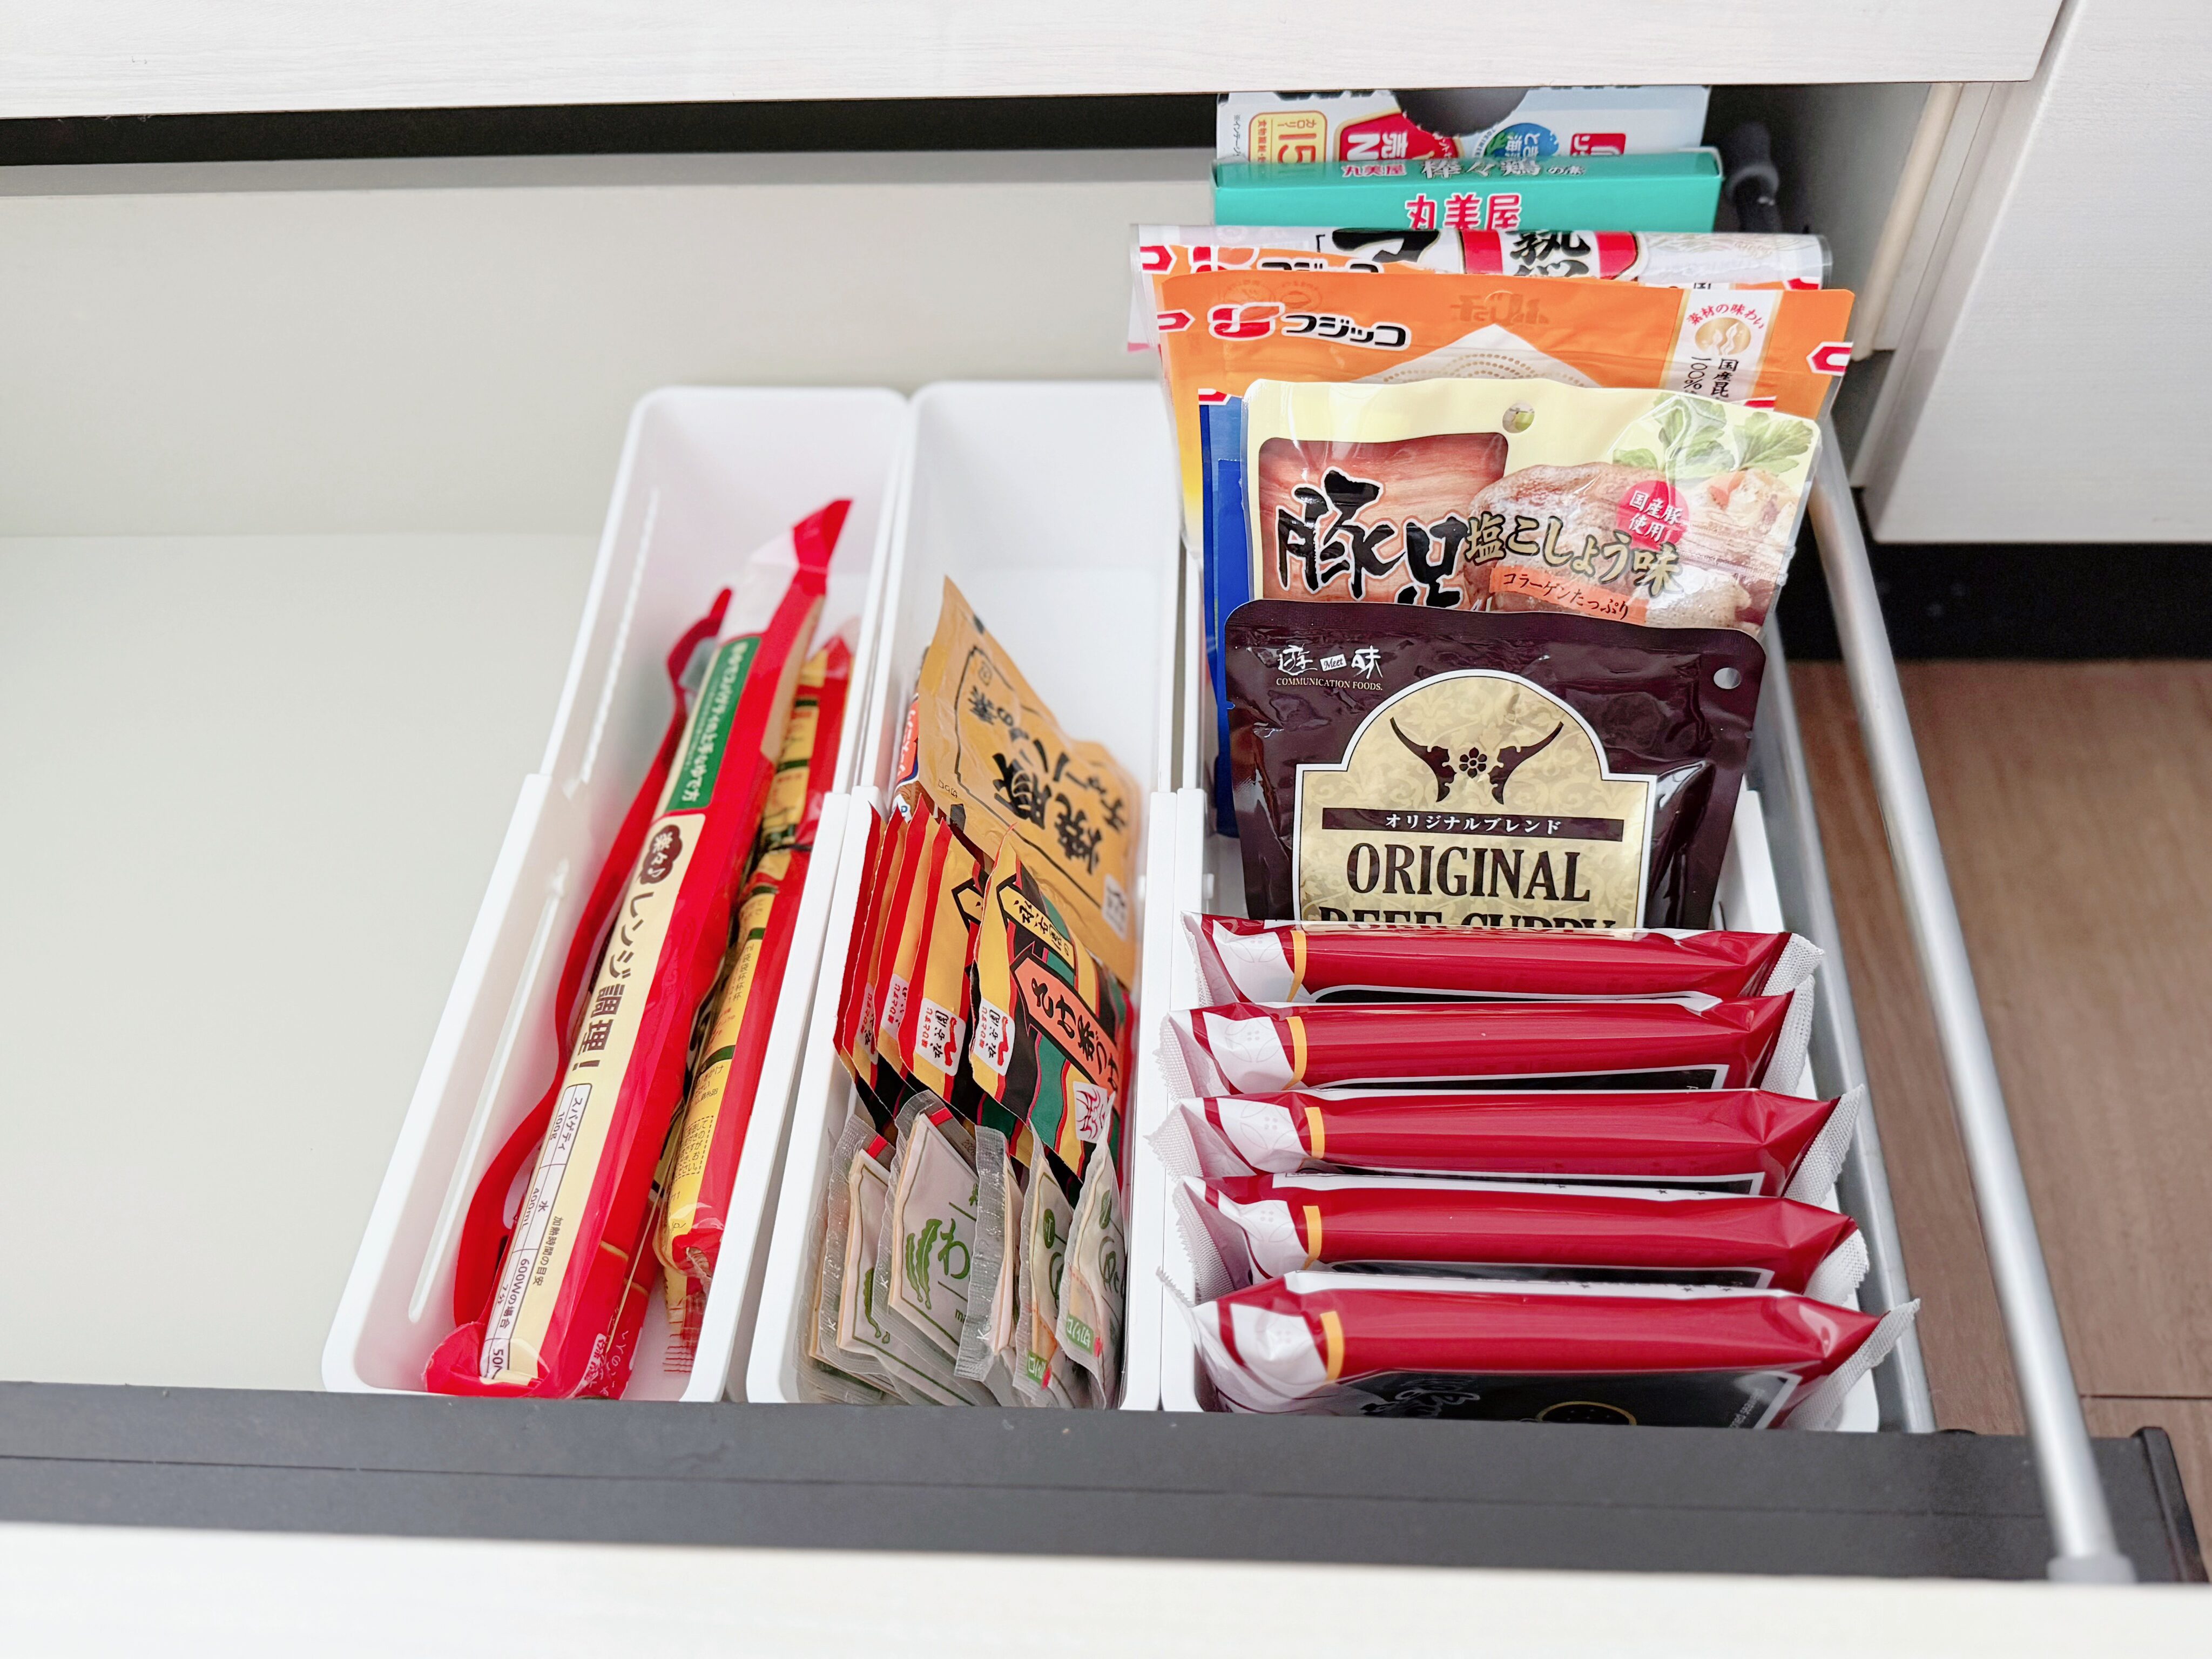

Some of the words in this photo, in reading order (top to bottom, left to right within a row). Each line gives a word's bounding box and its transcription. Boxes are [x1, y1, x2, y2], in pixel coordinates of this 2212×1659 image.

[1341, 164, 1406, 177] 丸美屋
[1405, 193, 1523, 229] 丸美屋
[1284, 313, 1408, 348] フジッコ
[1628, 489, 1683, 524] 国産豚
[1627, 515, 1667, 542] 使用
[1465, 510, 1683, 597] 塩こしょう味
[1502, 571, 1630, 621] コラーゲンたっぷり
[1276, 677, 1351, 689] COMMUNICATION
[1352, 681, 1384, 691] FOODS.
[1385, 812, 1562, 835] オリジナルブレンド
[1346, 841, 1591, 902] ORIGINAL
[558, 1097, 583, 1151] スパゲティ
[537, 1200, 549, 1212] 水
[532, 1215, 564, 1286] 加熱時間の目安
[499, 1258, 530, 1329] 600Wの場合
